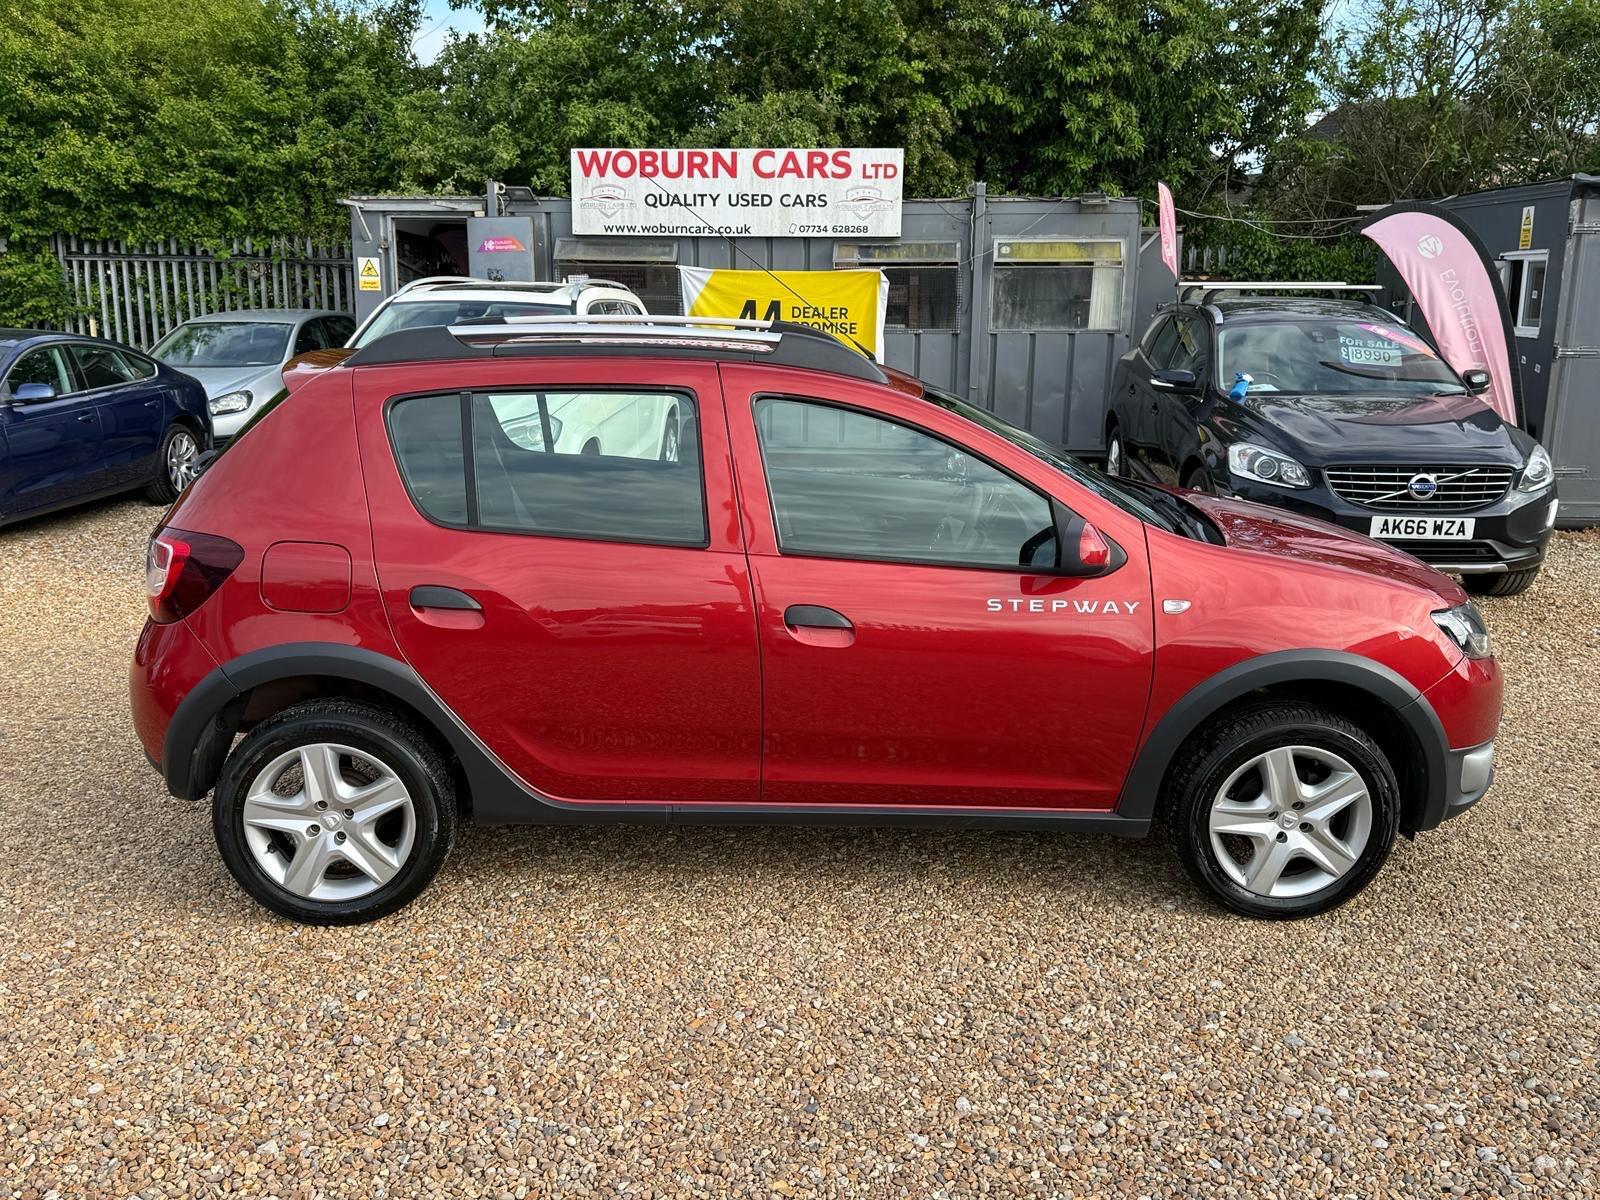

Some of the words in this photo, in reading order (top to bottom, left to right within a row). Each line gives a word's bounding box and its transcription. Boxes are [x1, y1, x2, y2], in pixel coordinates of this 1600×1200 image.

[577, 150, 738, 179] WOBURN
[752, 150, 852, 179] CARS
[862, 163, 898, 180] LTD
[644, 193, 721, 208] QUALITY
[728, 193, 773, 207] USED
[780, 193, 828, 207] CARS
[604, 223, 752, 235] www.woburncars.co.uk
[799, 224, 829, 234] 07734
[831, 225, 869, 234] 628268
[791, 306, 849, 319] DEALER
[791, 320, 858, 335] OMISE
[1340, 336, 1364, 347] FOR
[1367, 340, 1401, 349] SALE
[1379, 518, 1428, 536] AK66
[1432, 519, 1466, 537] WZA
[986, 598, 1140, 615] STEPWAY
